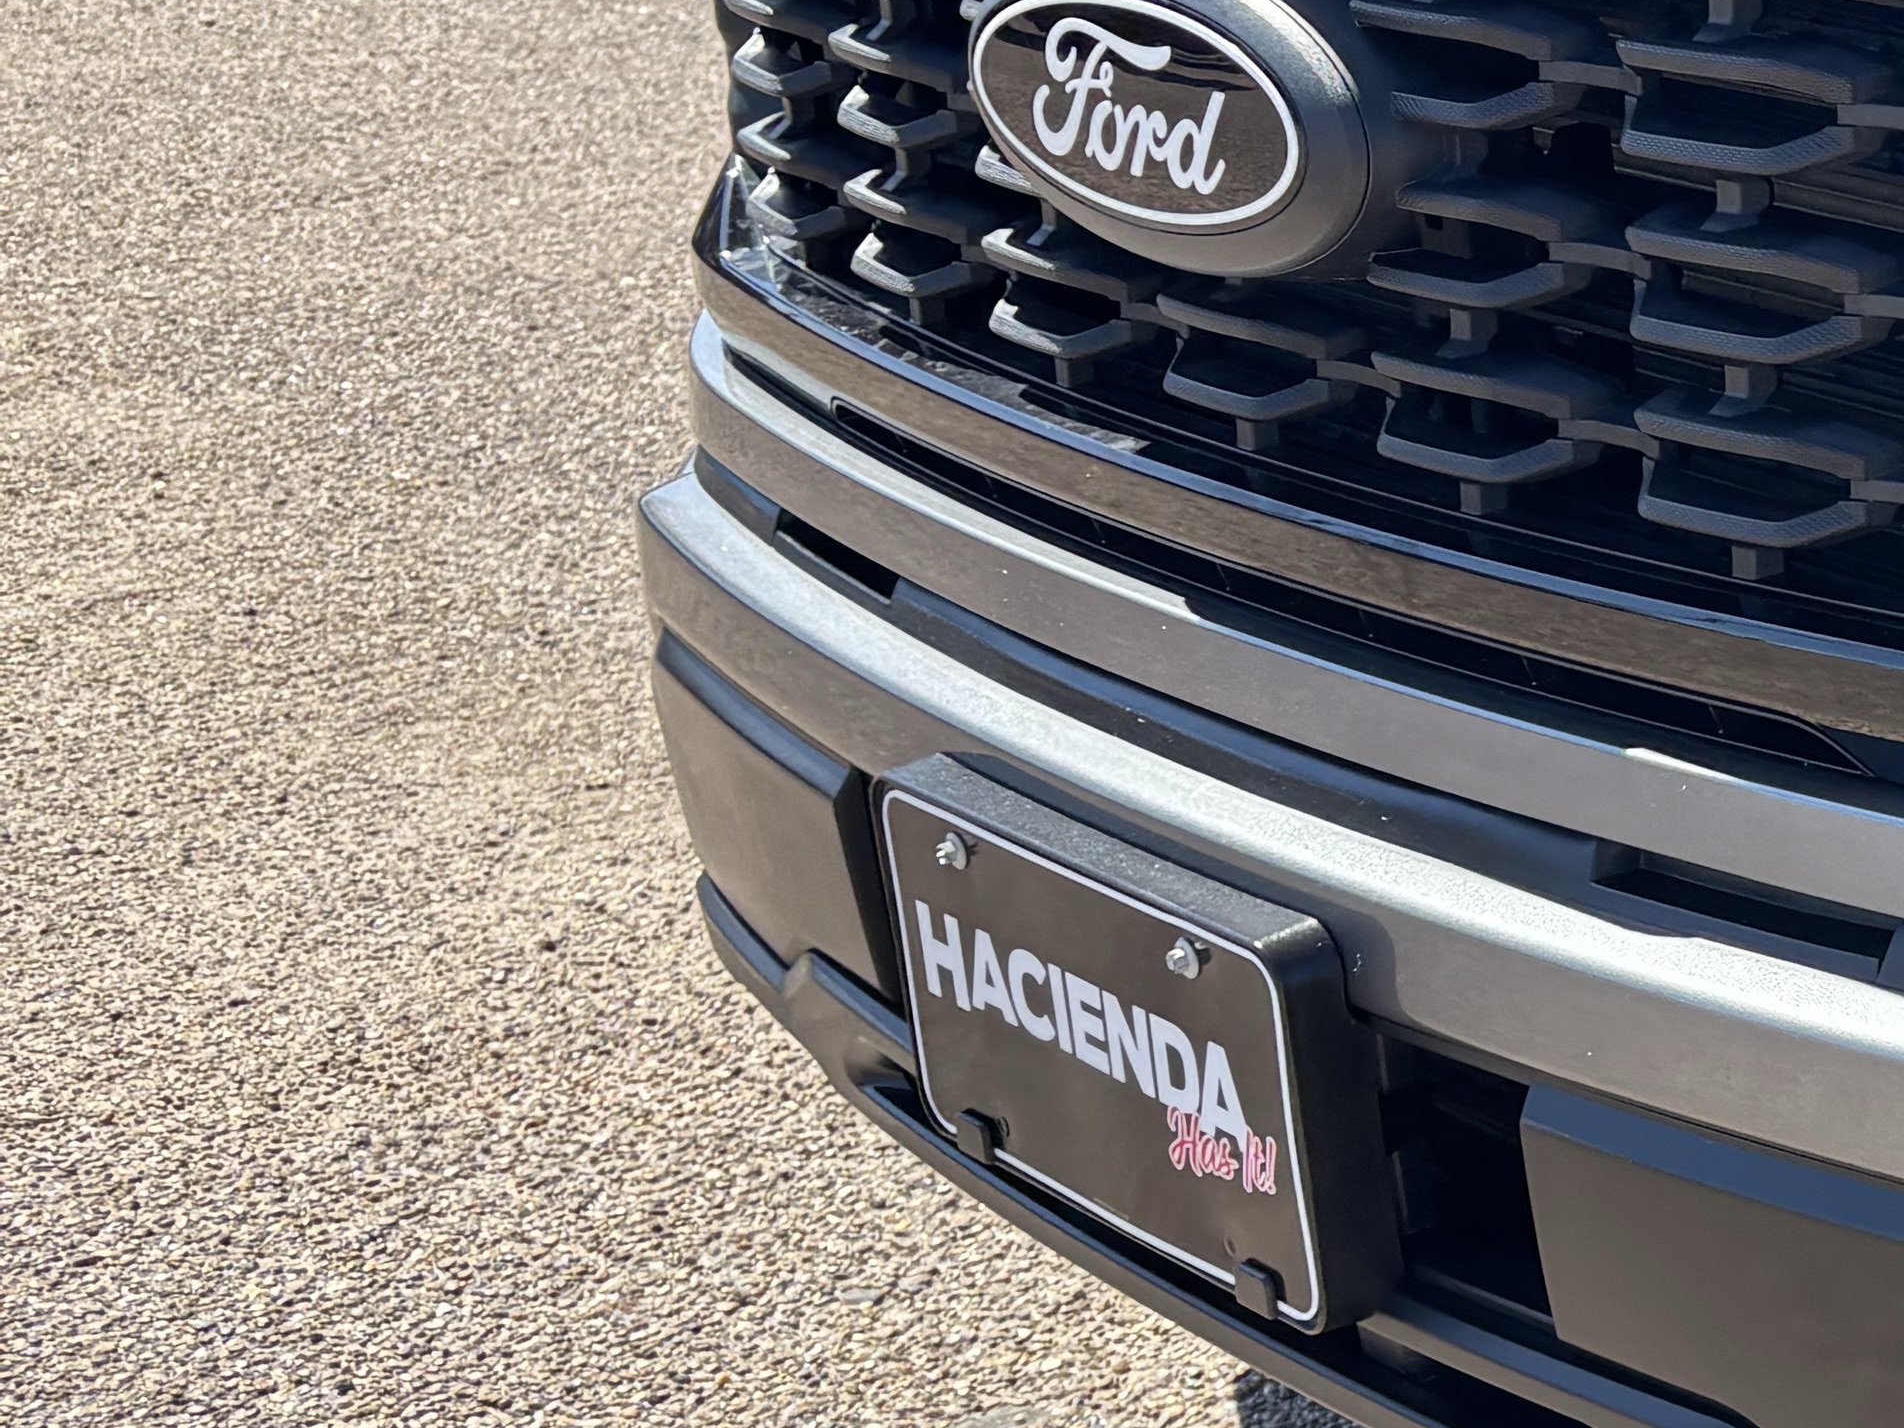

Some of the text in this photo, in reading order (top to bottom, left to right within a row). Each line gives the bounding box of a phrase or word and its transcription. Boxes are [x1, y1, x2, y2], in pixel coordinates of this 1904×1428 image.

[1033, 16, 1226, 195] Ford
[914, 899, 1247, 1153] HACIENDA
[1167, 1105, 1277, 1195] Has It!
